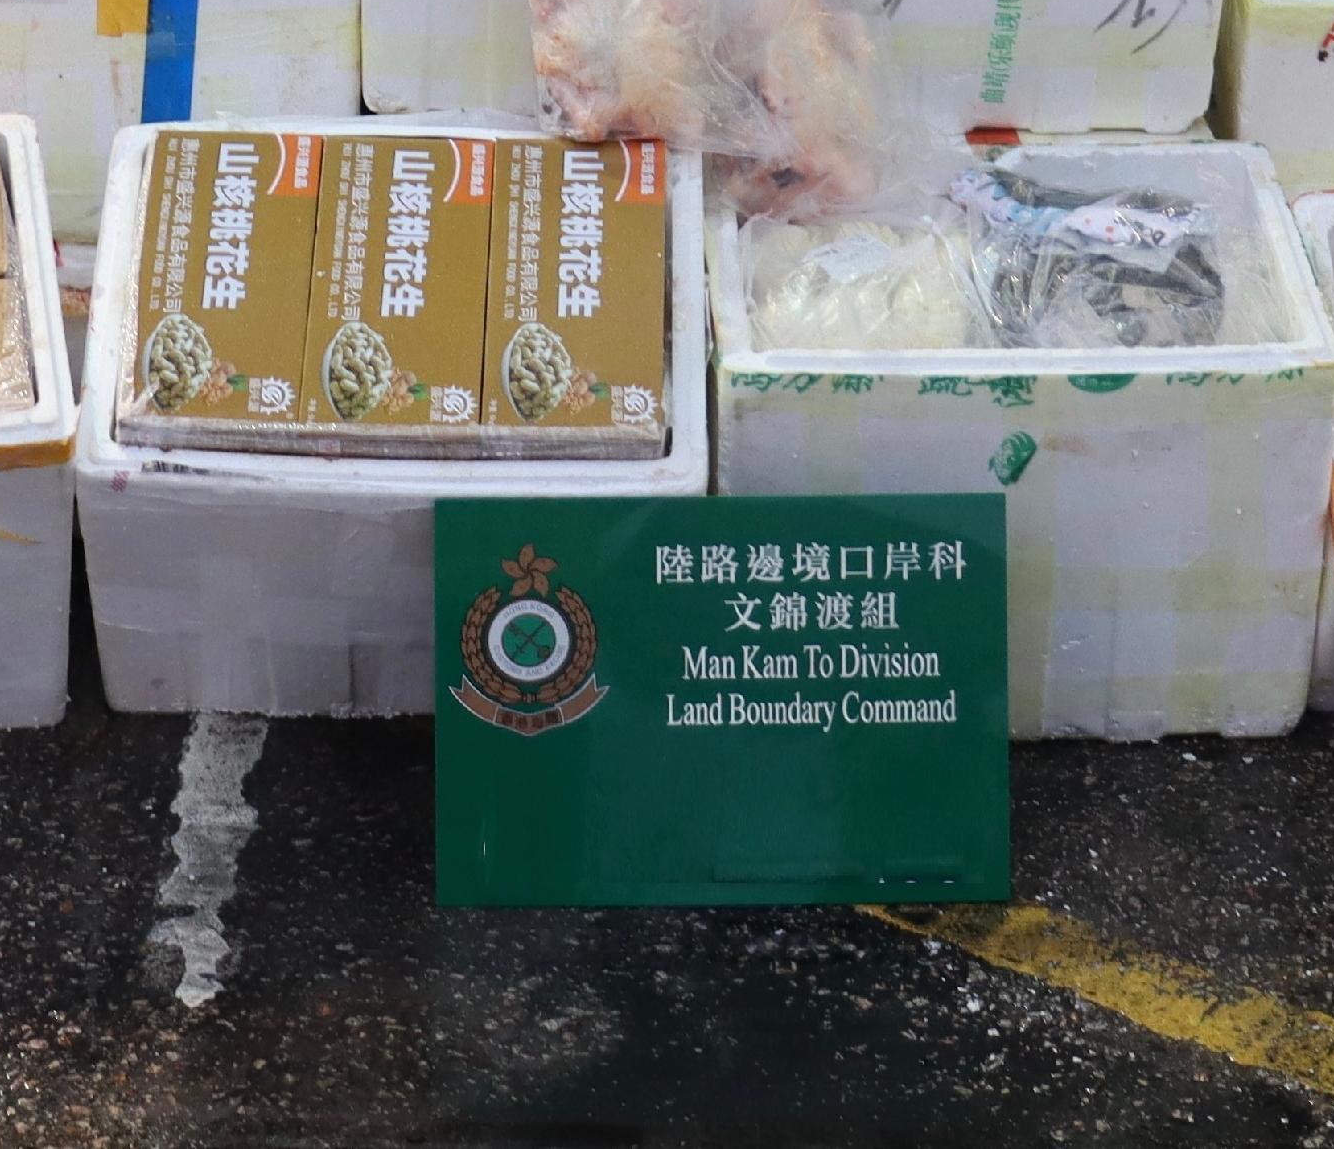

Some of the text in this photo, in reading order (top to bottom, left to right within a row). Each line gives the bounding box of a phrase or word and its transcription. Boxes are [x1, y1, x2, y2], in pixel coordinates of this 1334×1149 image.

[163, 138, 201, 314] 惠州市盛兴源食品有限公司
[201, 142, 260, 310] 山核桃花生
[341, 143, 375, 322] 惠州市盛兴源食品有限公司
[379, 149, 436, 318] 山核桃花生
[517, 144, 545, 323] 惠州市盛兴源食品有限公司
[557, 150, 605, 318] 山核桃花生
[654, 540, 967, 585] 陸路邊境口岸科
[724, 591, 899, 633] 文錦渡組
[667, 690, 957, 733] Land Boundary Command
[680, 642, 941, 680] Man Kam To Division
